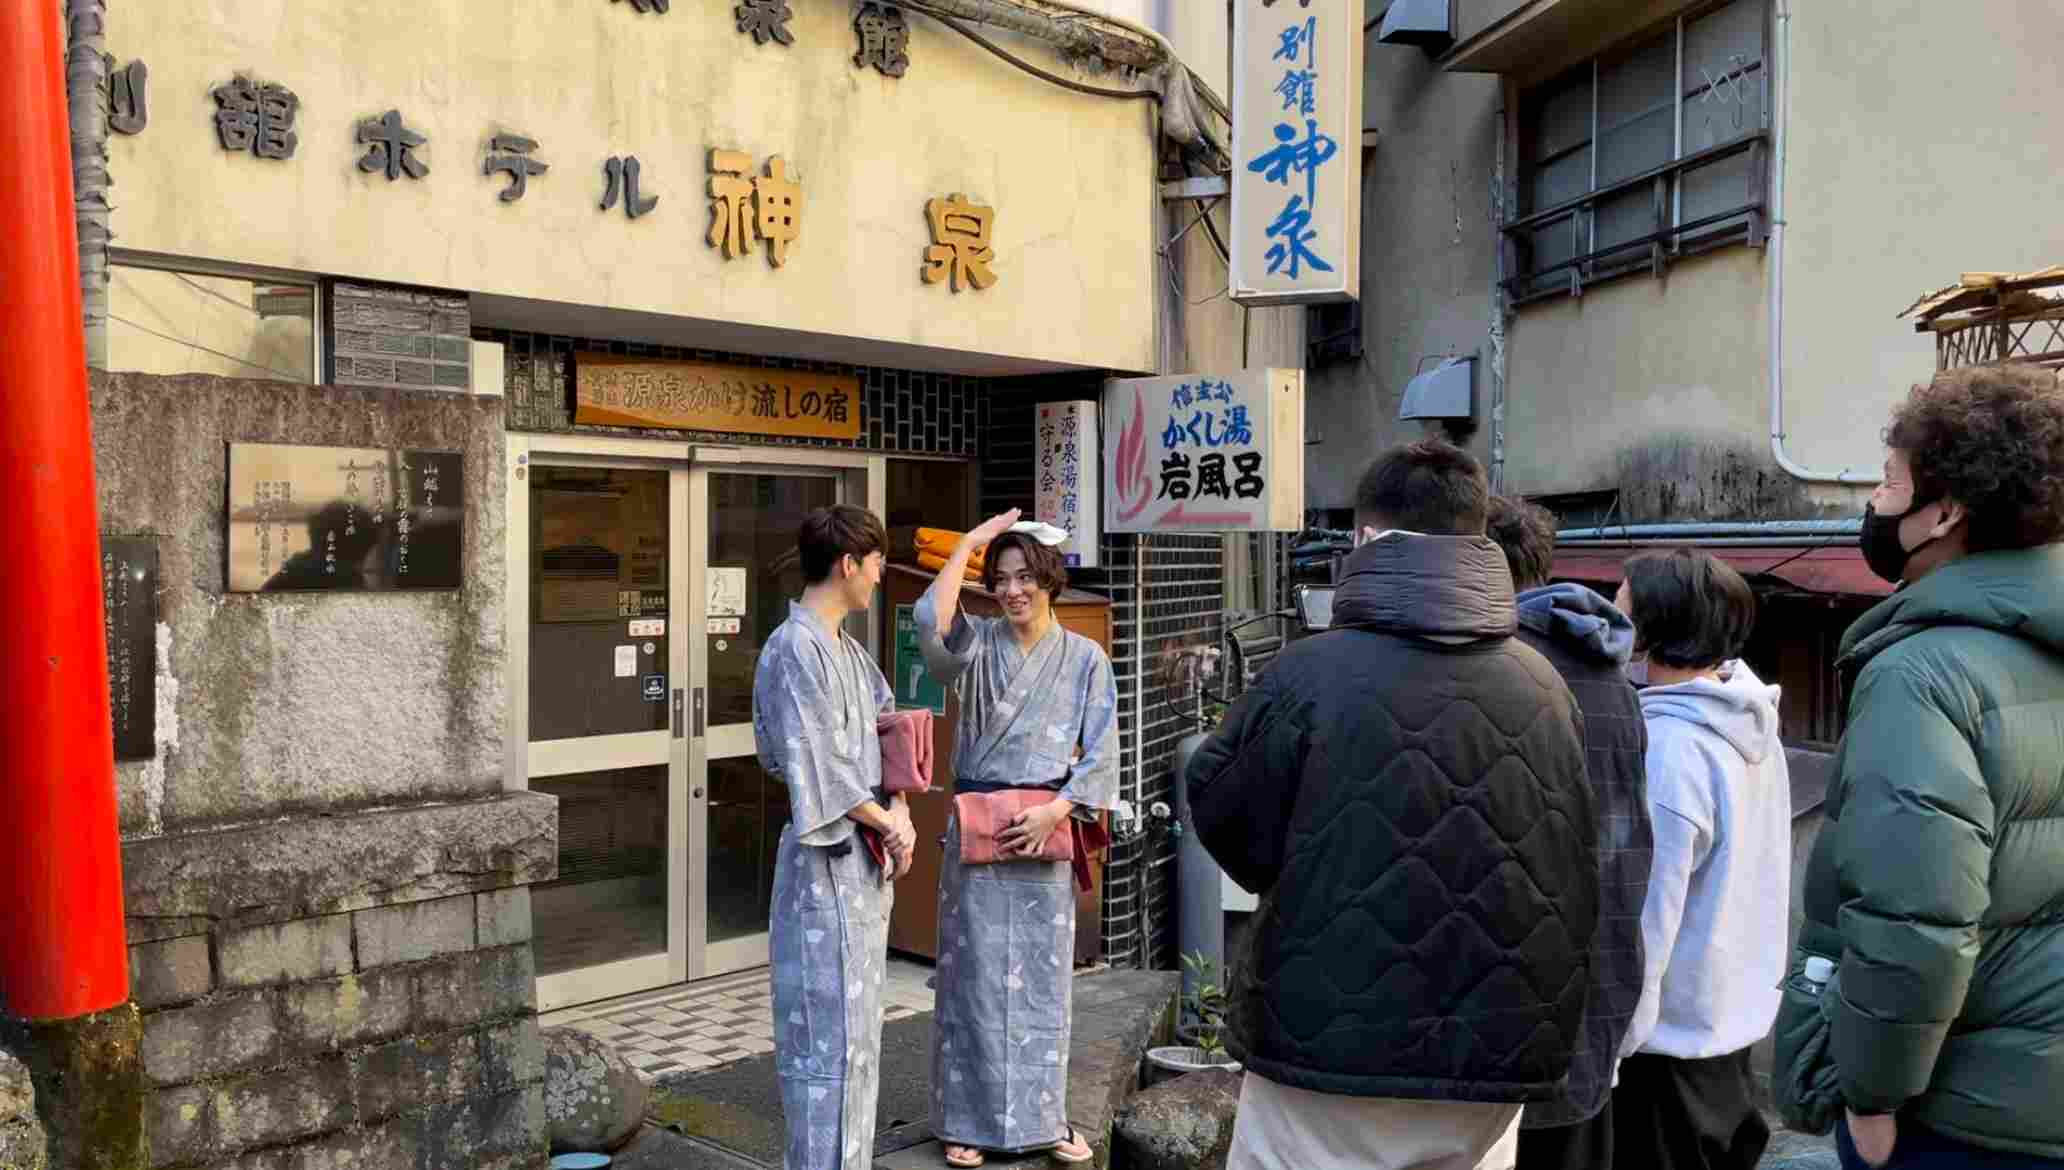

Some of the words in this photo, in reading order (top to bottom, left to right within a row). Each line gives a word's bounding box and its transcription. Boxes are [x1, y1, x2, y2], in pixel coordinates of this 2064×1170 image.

[1161, 405, 1253, 450] かくし湯
[1156, 451, 1265, 501] 岩風呂
